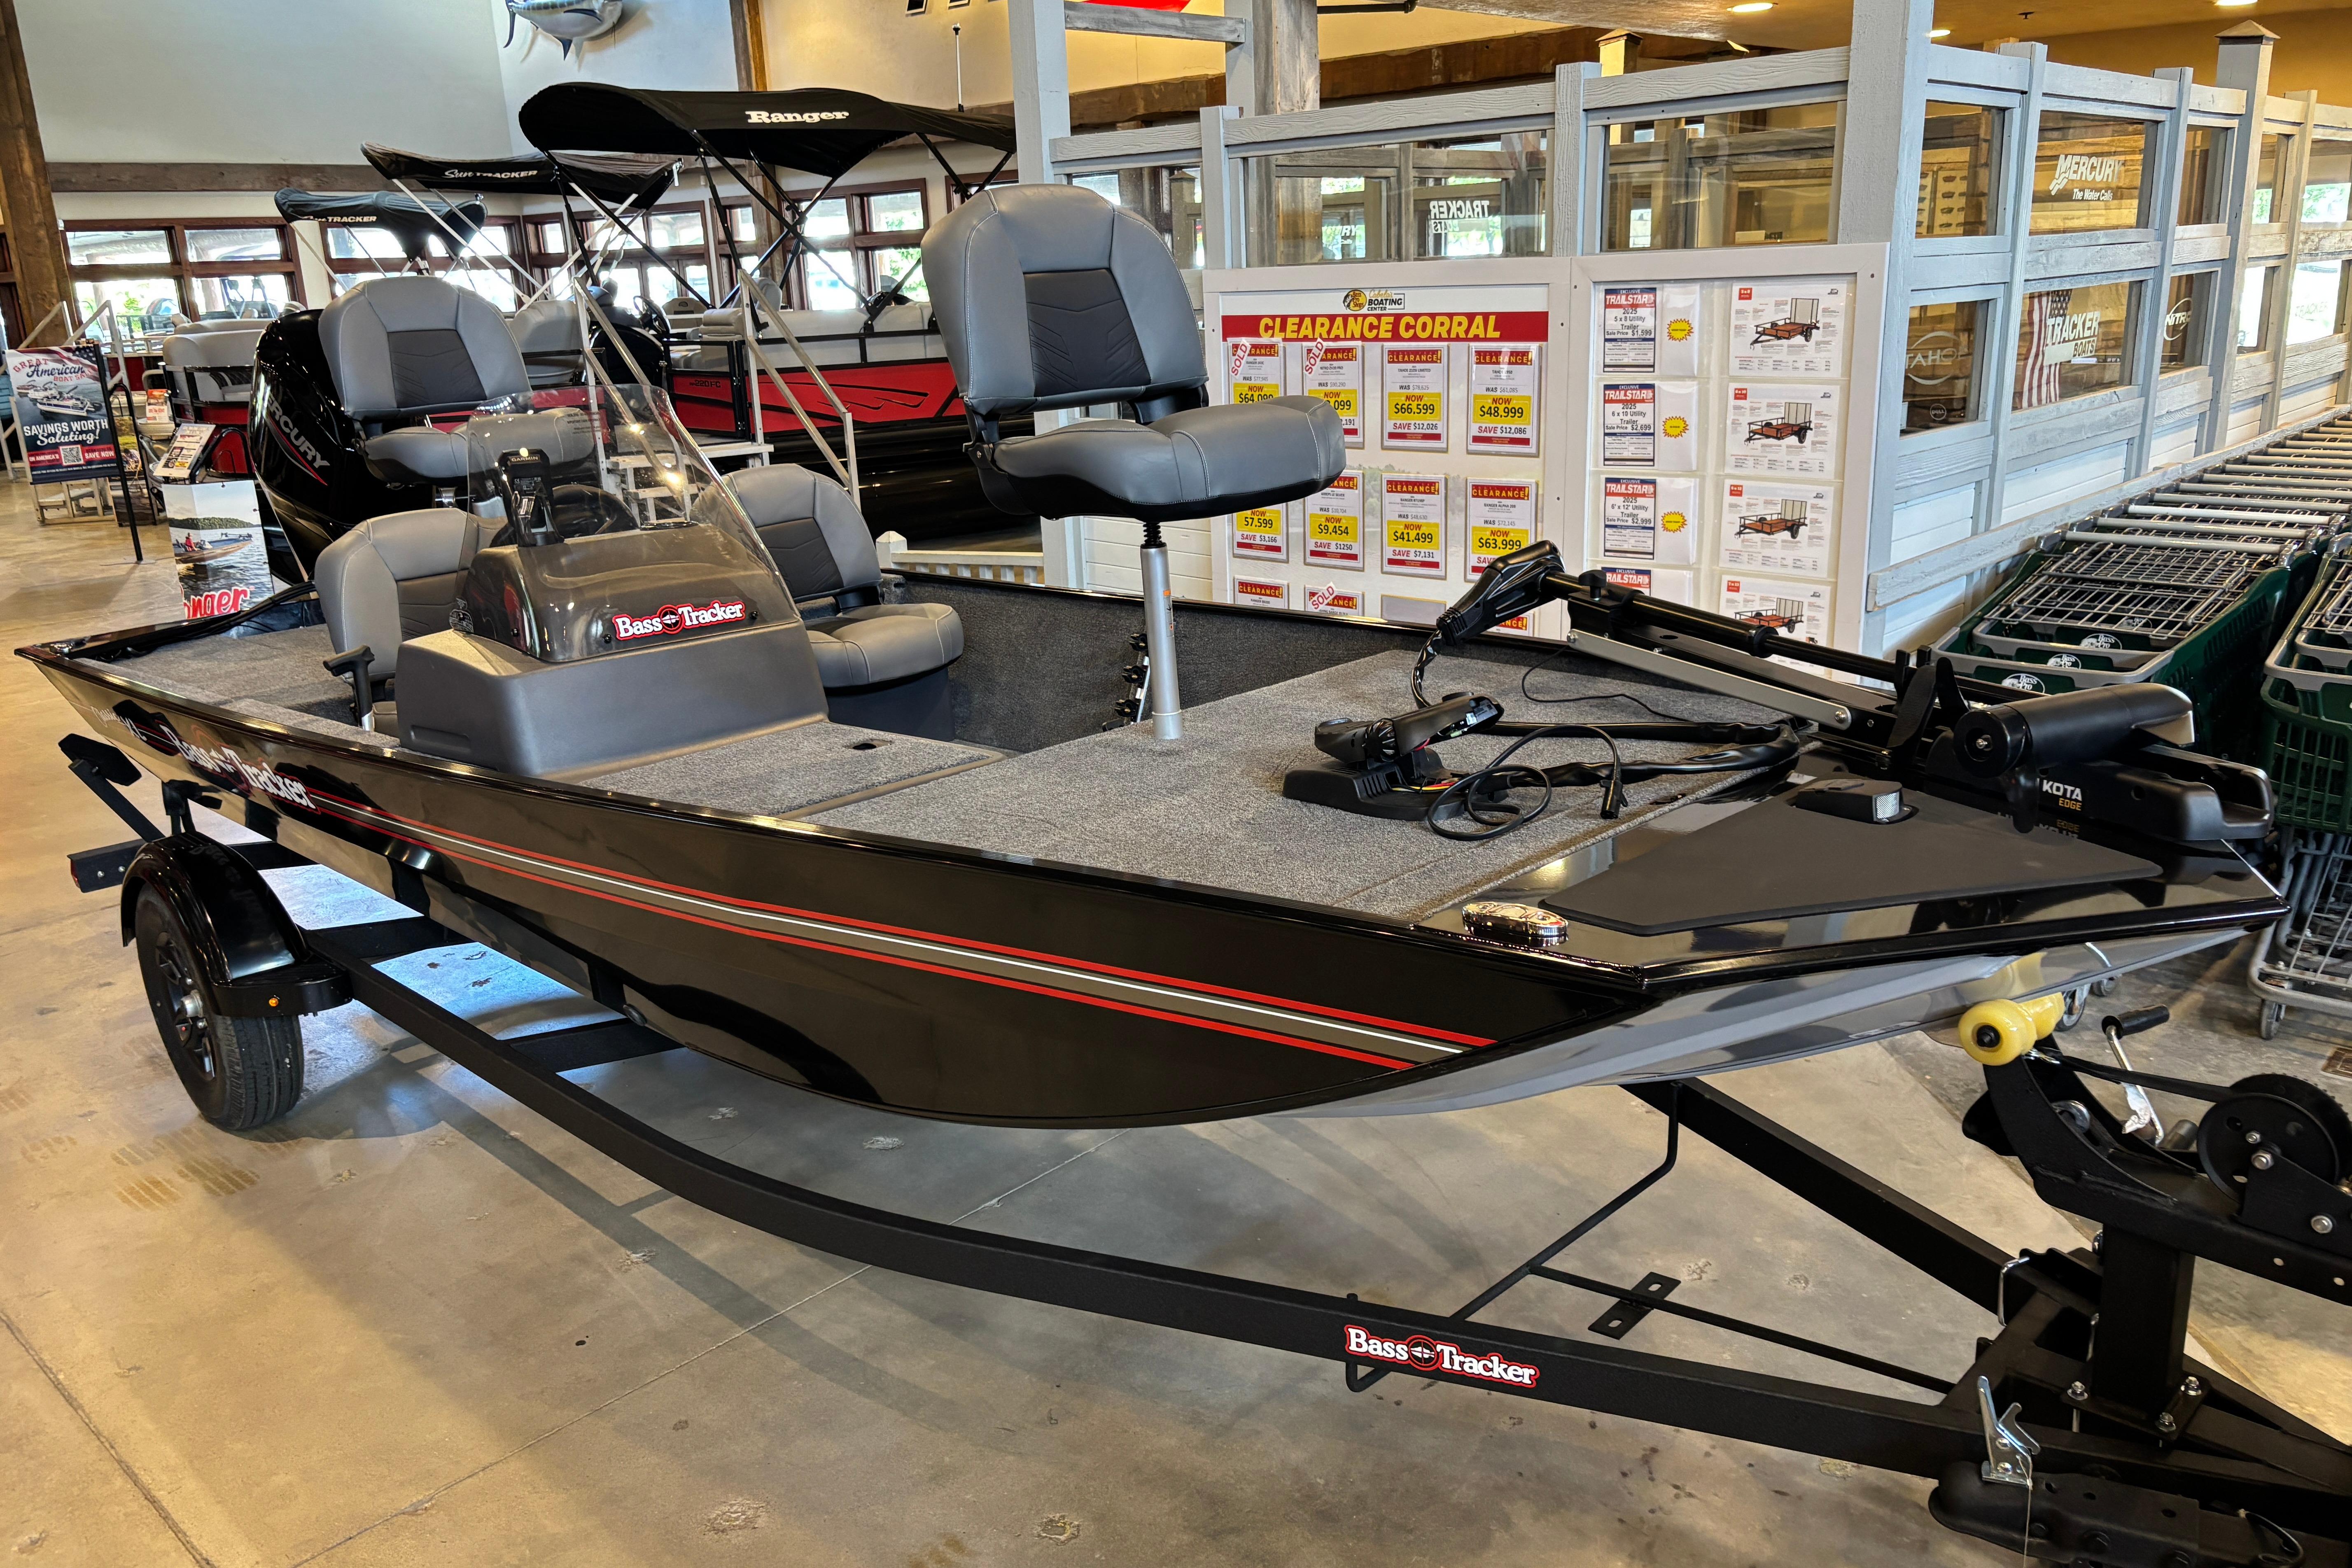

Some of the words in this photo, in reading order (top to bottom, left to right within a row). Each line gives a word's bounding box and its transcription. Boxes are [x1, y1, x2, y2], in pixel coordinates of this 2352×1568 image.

[745, 111, 849, 123] Ranger
[441, 169, 474, 178] Sun
[2053, 154, 2125, 183] MERCURY
[2073, 189, 2083, 200] The
[2084, 189, 2100, 201] Water
[2100, 189, 2113, 201] Calls
[1606, 294, 1647, 305] TRAILSTAR
[1259, 316, 1394, 339] CLEARANCE
[1400, 315, 1501, 338] CORRAL
[2046, 311, 2100, 345] TRACKER
[2073, 339, 2095, 357] BOATS
[1231, 343, 1248, 376] SOLD
[1305, 341, 1323, 375] SOLD
[1388, 350, 1441, 363] CLEARANCE!
[1475, 351, 1531, 365] CLEARANCE!
[13, 358, 49, 373] GREAT
[26, 364, 85, 378] American
[1605, 390, 1647, 400] TRAILSTAR
[23, 422, 69, 436] SAVINGS
[70, 418, 109, 432] WORTH
[1414, 422, 1438, 430] $12,026
[1478, 426, 1498, 434] SAVE
[1500, 426, 1527, 435] $12,086
[37, 429, 100, 446] Saluting!
[1387, 482, 1438, 495] CLEARANCE!
[1472, 487, 1529, 500] CLEARANCE!
[1606, 484, 1647, 494] TRAILSTAR
[1241, 533, 1257, 541] SAVE
[1259, 534, 1277, 543] $3,166
[1335, 542, 1353, 551] $1250
[1414, 550, 1434, 558] $7,131
[1606, 573, 1643, 584] RAILSTAR
[1239, 585, 1283, 598] CLEARANCE!
[1311, 586, 1334, 609] SOLD
[615, 614, 662, 638] Bass
[678, 602, 743, 626] Tracker
[2098, 635, 2115, 644] Bass
[2019, 675, 2038, 684] Bass
[159, 724, 221, 773] Bass
[222, 747, 316, 809] Tracker
[2042, 779, 2082, 801] KOTA
[2059, 798, 2082, 811] EDGE
[1347, 1327, 1409, 1360] Bass
[1436, 1344, 1536, 1385] Tracker
